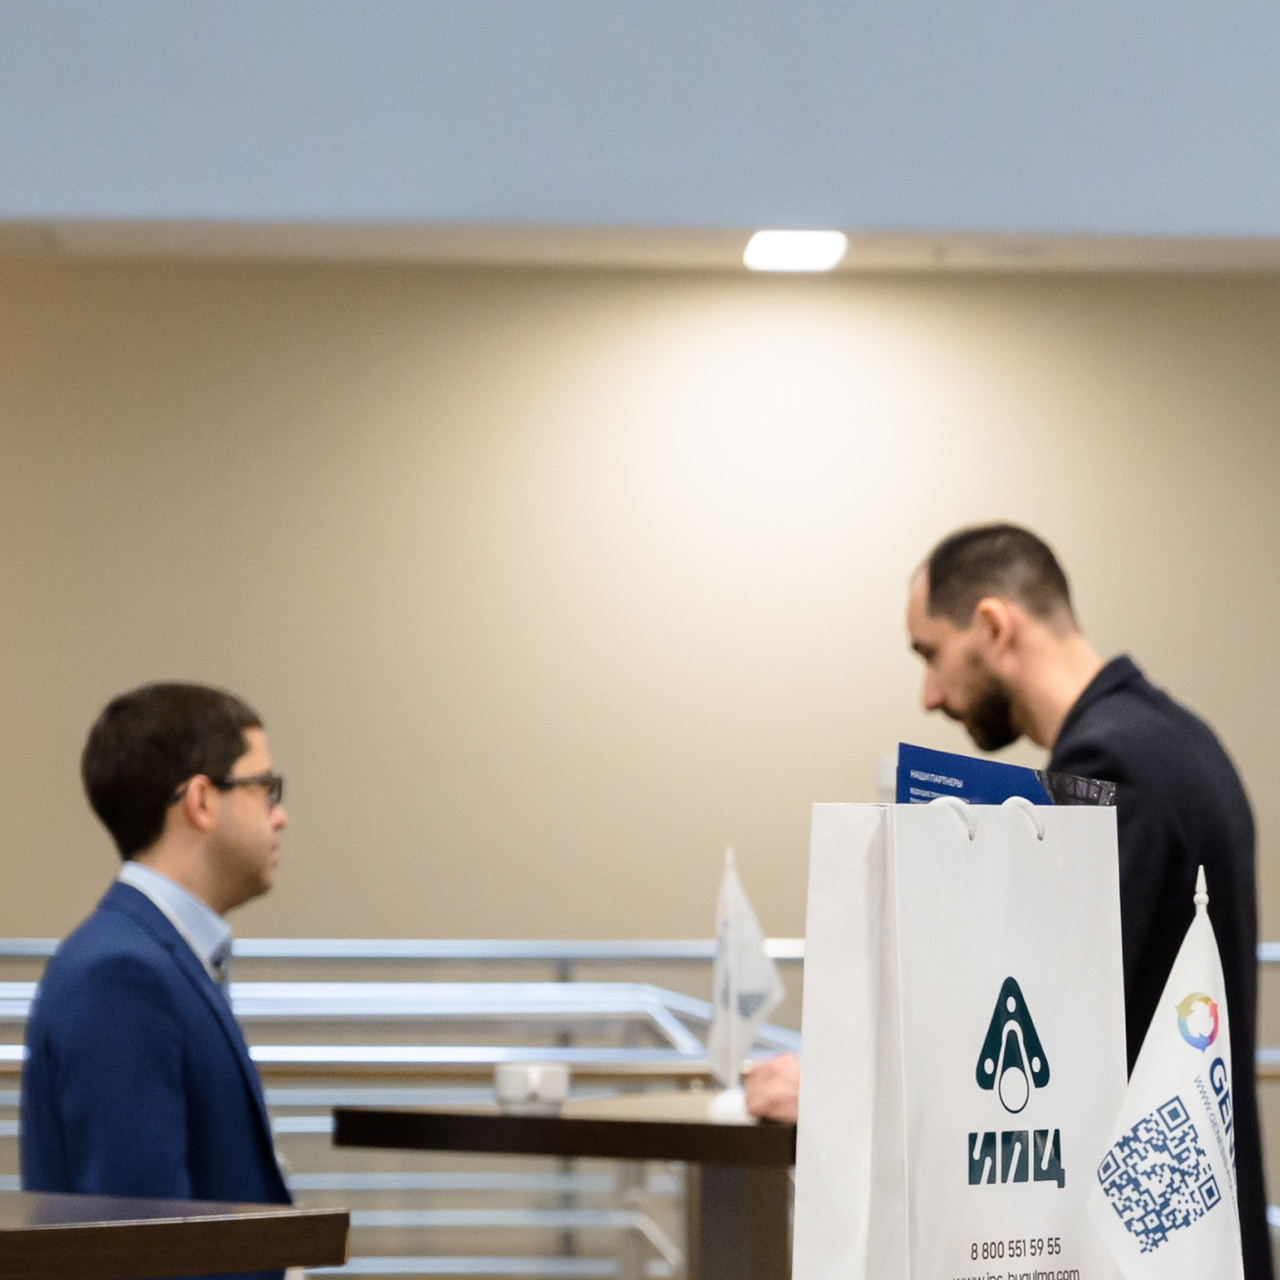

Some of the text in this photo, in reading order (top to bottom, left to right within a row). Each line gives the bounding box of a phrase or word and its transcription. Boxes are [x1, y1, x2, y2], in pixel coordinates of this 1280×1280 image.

[968, 1128, 1065, 1188] ИПЦ
[971, 1237, 1061, 1260] 8 800 551 59 55
